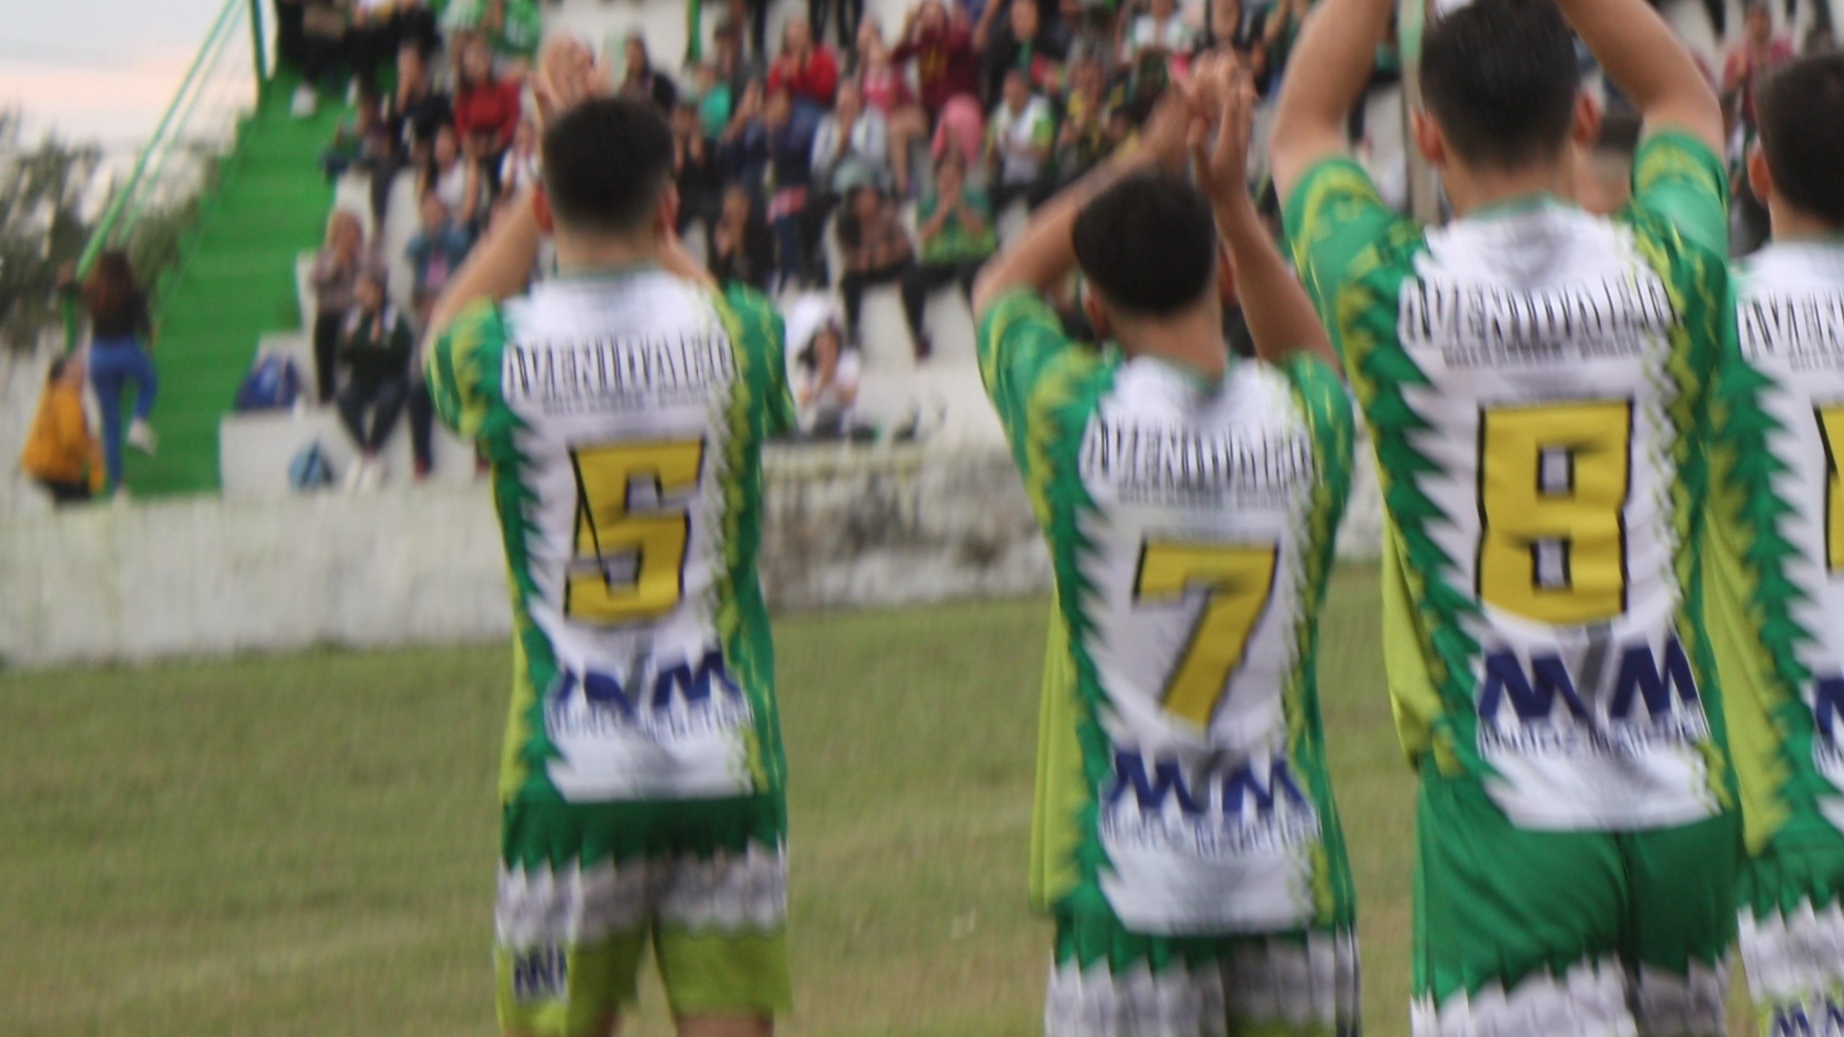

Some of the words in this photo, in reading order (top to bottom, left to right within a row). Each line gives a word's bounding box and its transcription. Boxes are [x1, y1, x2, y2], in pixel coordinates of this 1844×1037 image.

[563, 435, 706, 626] 5
[1473, 399, 1635, 629] 8
[1131, 538, 1281, 729] 7
